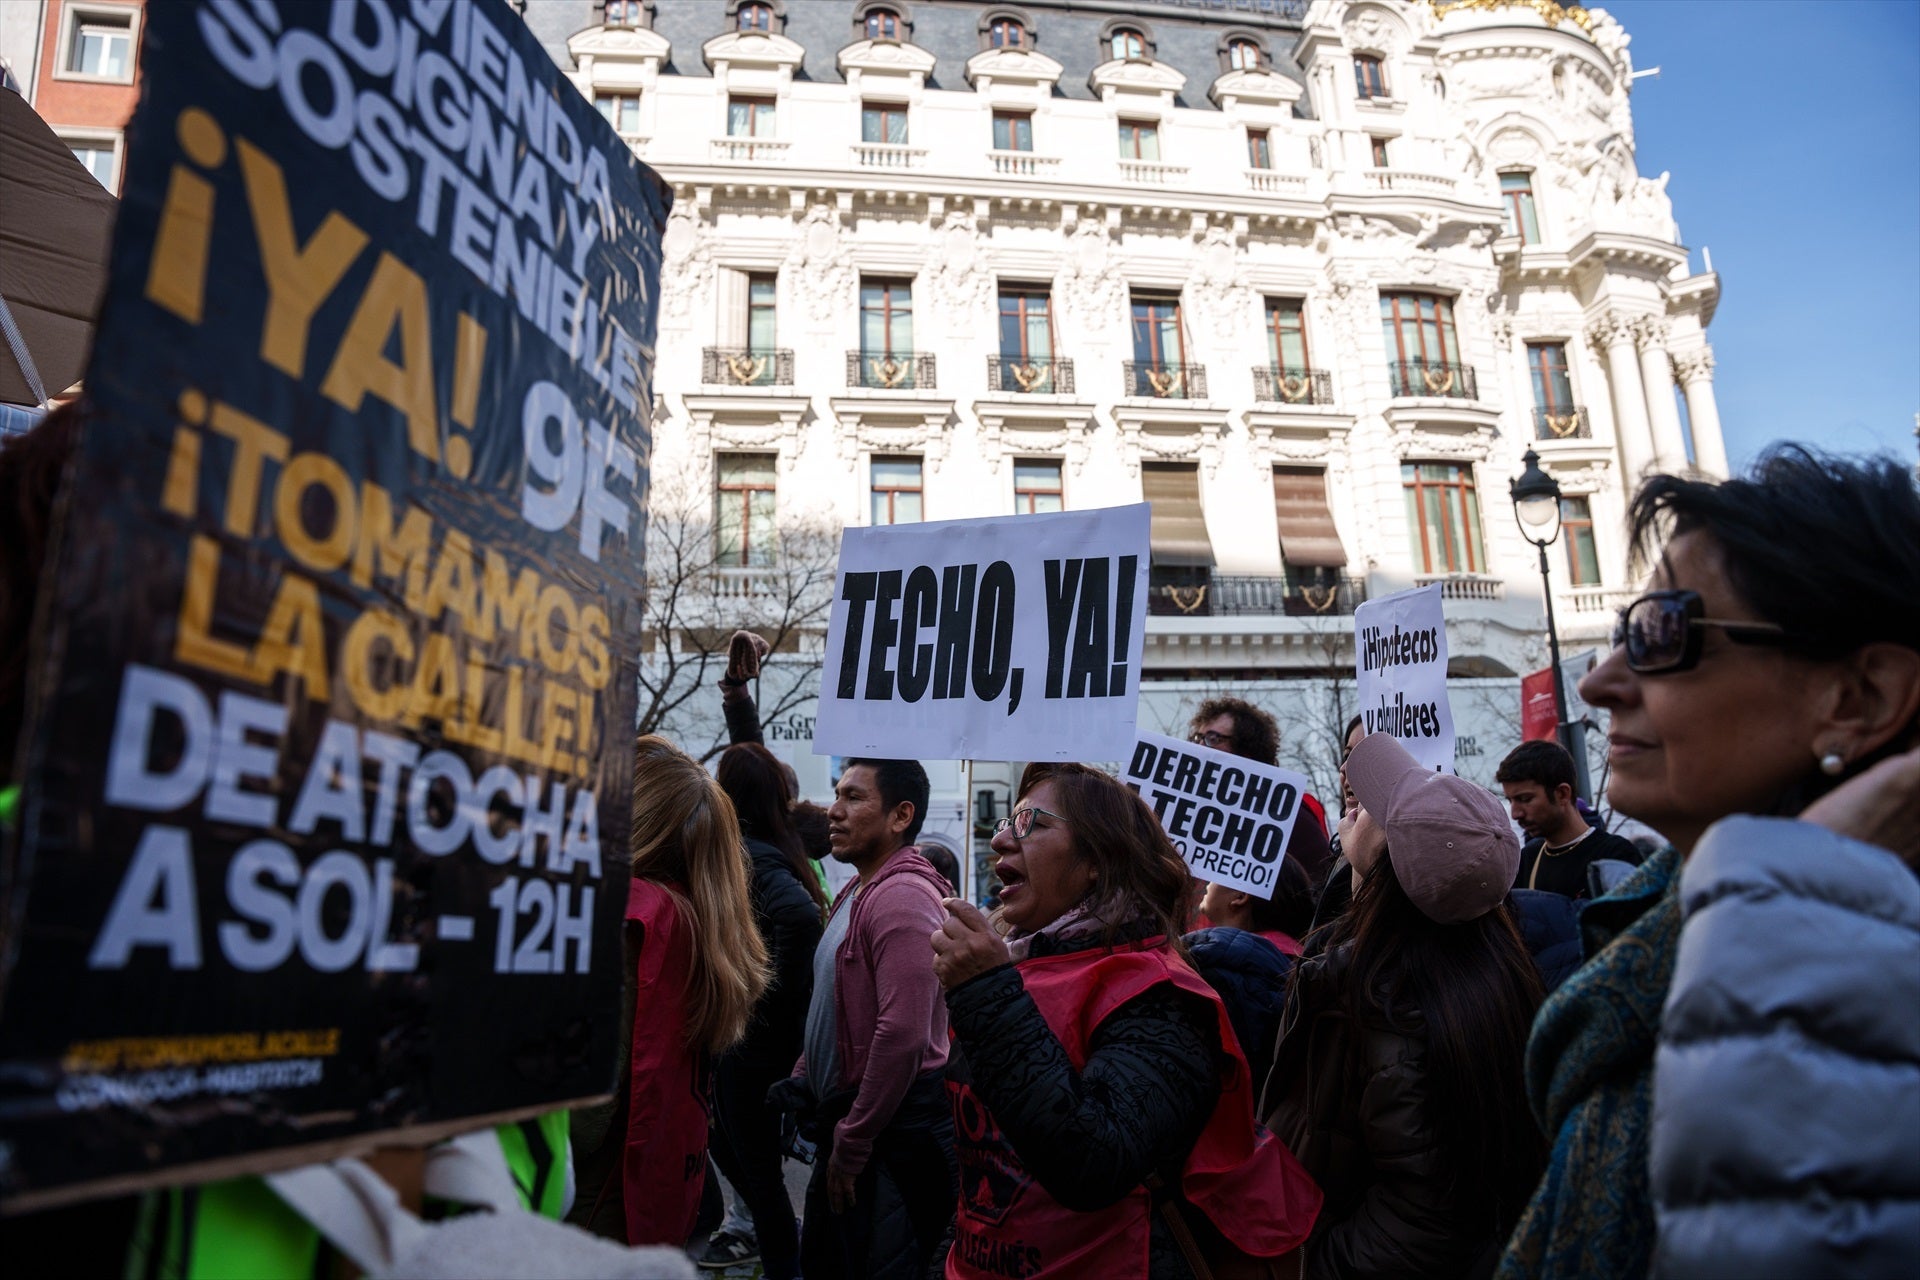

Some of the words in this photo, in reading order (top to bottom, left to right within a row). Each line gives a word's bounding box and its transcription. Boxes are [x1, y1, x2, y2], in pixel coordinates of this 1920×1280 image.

[198, 0, 641, 415] SOSTENIBLE
[328, 0, 556, 249] DIGNA
[143, 106, 489, 481] ¡YA!
[160, 389, 612, 690] ¡TOMAMOS
[522, 380, 637, 563] 9F
[174, 535, 331, 700] LA
[342, 608, 595, 780] CALLE!
[836, 560, 1025, 717] TECHO,
[1043, 554, 1138, 699] YA!
[104, 662, 289, 828] DE
[286, 720, 603, 878] ATOCHA
[1127, 740, 1297, 822] DERECHO
[1151, 789, 1284, 864] TECHO
[1190, 846, 1274, 888] PRECIO!
[88, 823, 203, 969] A
[217, 838, 420, 972] SOL
[438, 915, 474, 940] -
[488, 876, 596, 975] 12H
